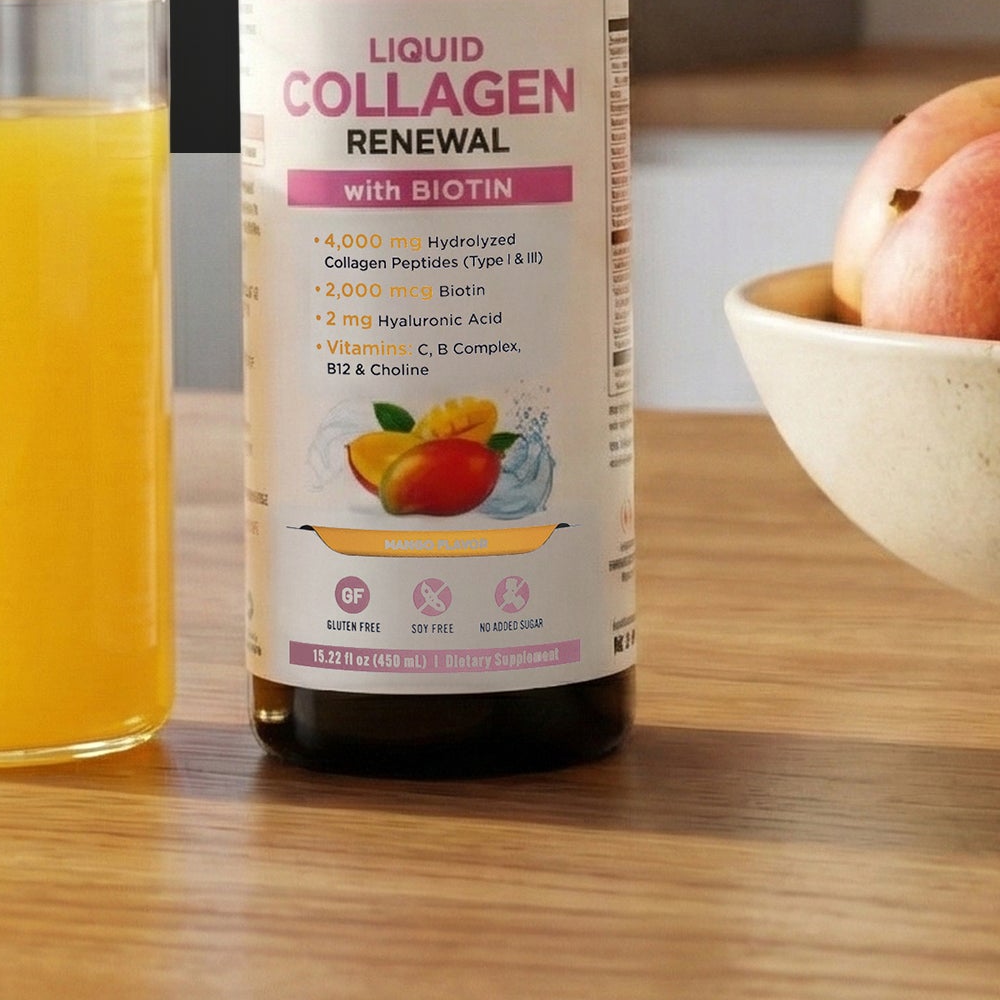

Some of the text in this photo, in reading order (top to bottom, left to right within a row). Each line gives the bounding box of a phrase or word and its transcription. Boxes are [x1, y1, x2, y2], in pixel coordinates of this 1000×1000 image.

[369, 36, 484, 63] LIQUID
[283, 67, 575, 118] COLLAGEN
[346, 127, 510, 155] RENEWAL
[344, 177, 513, 202] with BIOTIN
[324, 233, 516, 251] 4,000 mg Hydrolyzed
[324, 256, 387, 271] Collagen
[391, 256, 459, 271] Peptides
[463, 253, 504, 269] (Type
[514, 253, 524, 265] &
[527, 251, 544, 265] III)
[325, 282, 486, 301] 2,000 mcg Biotin
[325, 311, 503, 330] 2 mg Hyaluronic Acid
[326, 339, 522, 357] Vitamins: C, B Complex,
[327, 362, 430, 377] B12 & Choline
[384, 538, 489, 551] MANGO FLAVOR
[341, 586, 366, 605] GF
[327, 619, 381, 633] GLUTEN FREE
[411, 623, 454, 634] SOY FREE
[479, 617, 544, 633] NO ADDED SUGAR
[313, 648, 342, 665] 15.22
[344, 649, 353, 666] fl
[356, 655, 370, 667] oz
[373, 653, 401, 669] (450
[403, 654, 428, 670] mL)
